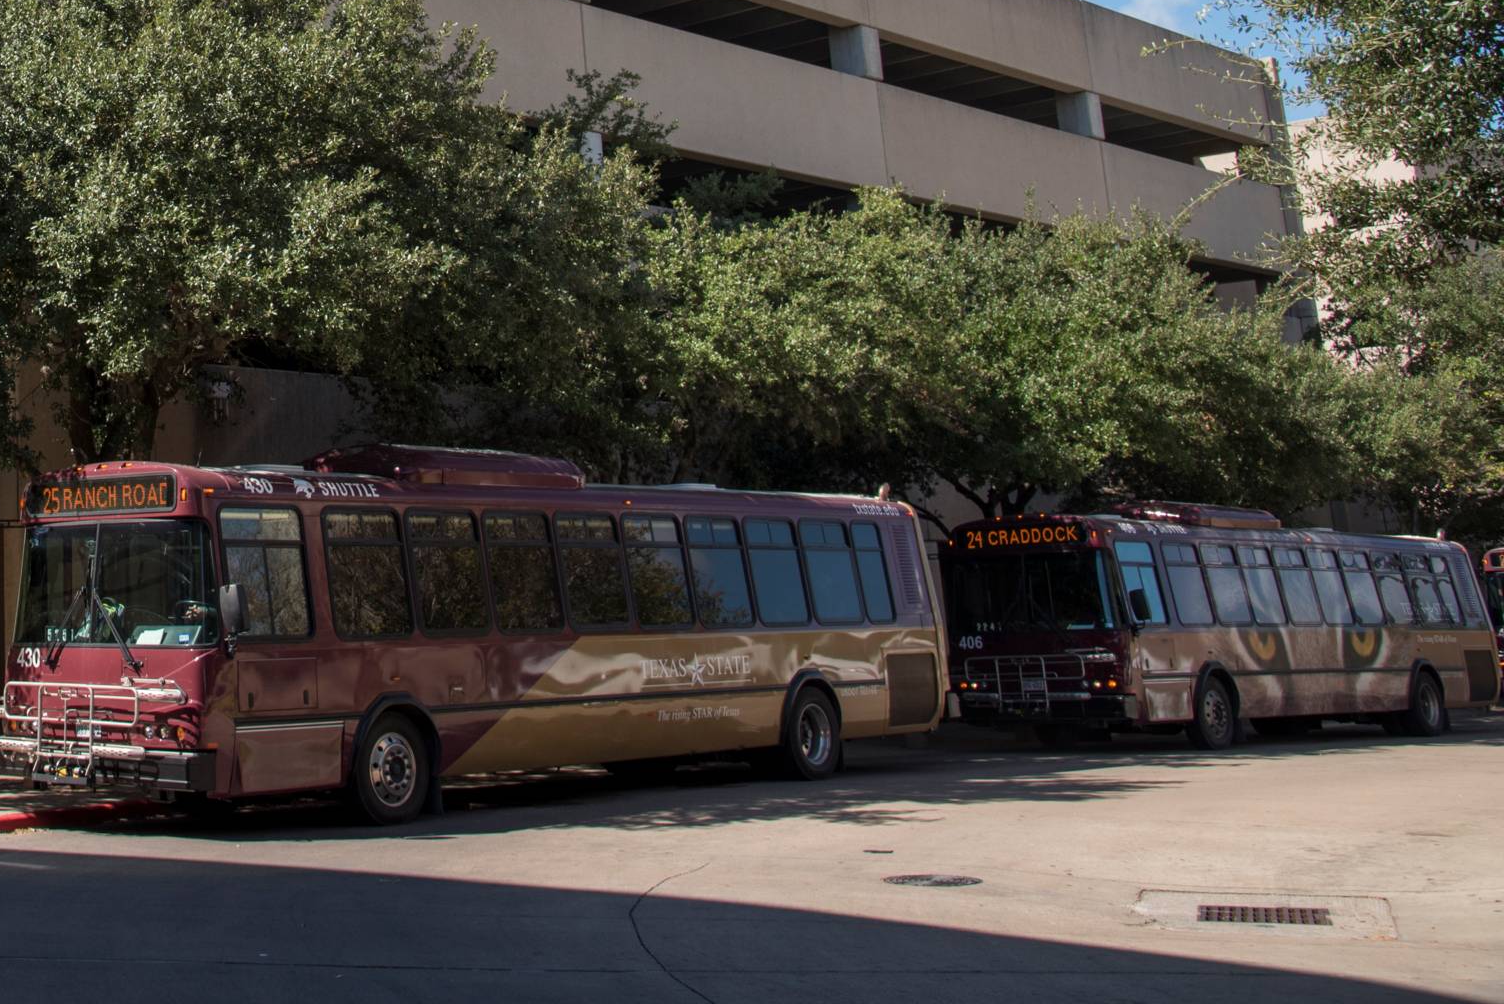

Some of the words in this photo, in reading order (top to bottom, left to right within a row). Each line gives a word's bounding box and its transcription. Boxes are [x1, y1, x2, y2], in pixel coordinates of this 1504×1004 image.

[243, 477, 273, 494] 430
[318, 482, 380, 498] SHUTTLE
[43, 486, 60, 514] 25
[63, 484, 117, 510] RANCH
[966, 531, 983, 549] 24
[988, 526, 1078, 546] CRADDOCK
[959, 636, 983, 649] 406
[17, 647, 40, 668] 430
[640, 658, 686, 679] TEXAS
[706, 654, 751, 676] STATE
[692, 707, 713, 719] STAR
